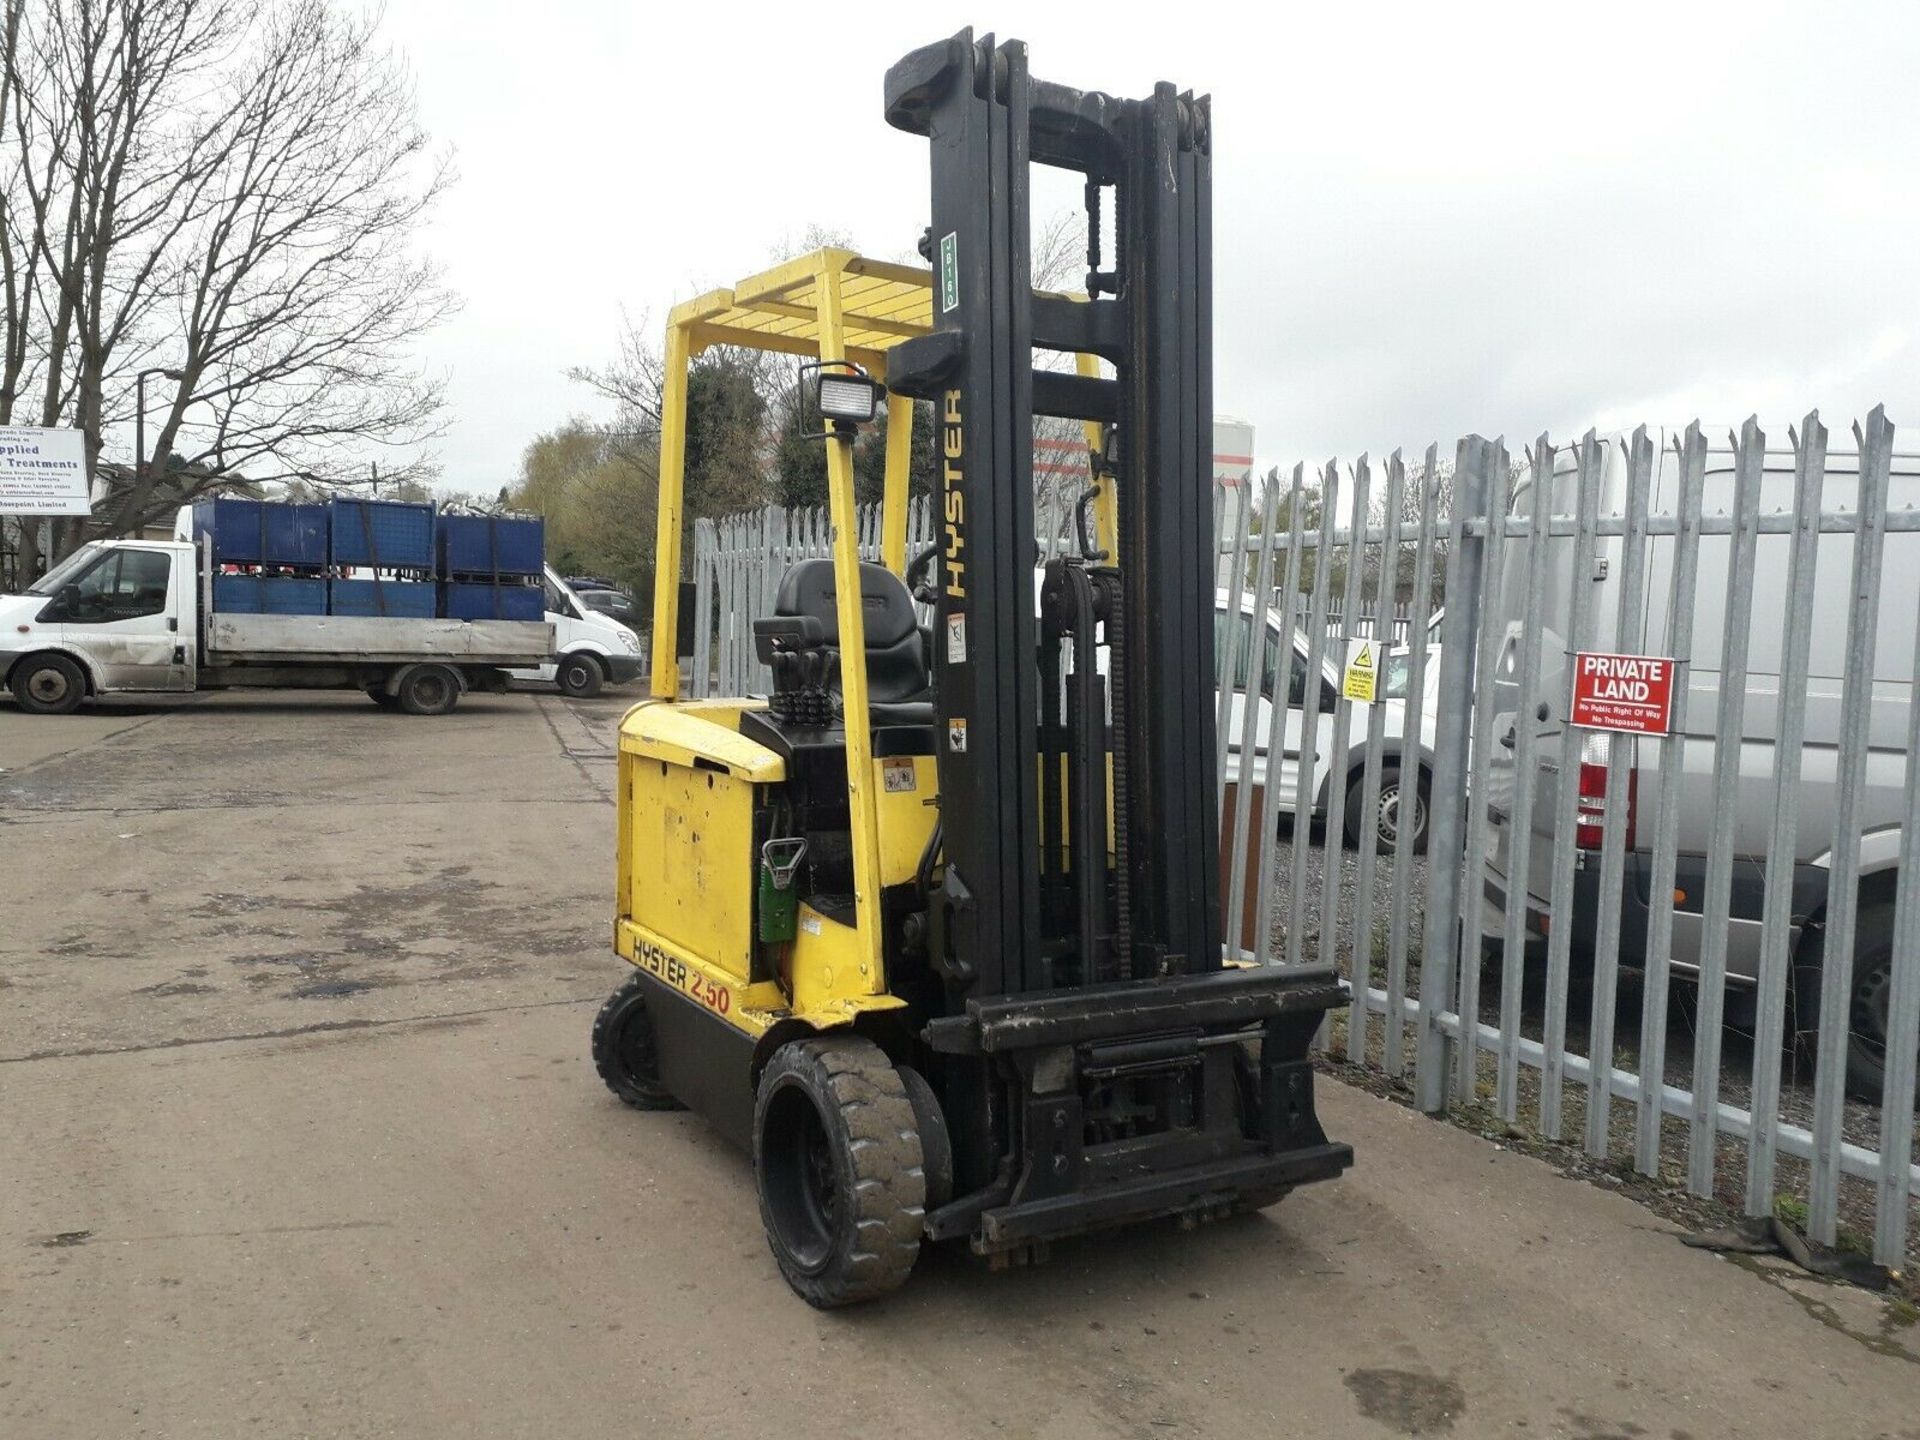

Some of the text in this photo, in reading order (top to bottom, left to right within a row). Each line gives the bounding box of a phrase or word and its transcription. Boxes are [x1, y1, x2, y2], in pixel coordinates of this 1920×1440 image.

[7, 458, 78, 468] Treatments
[943, 389, 965, 598] HYSTER
[1584, 657, 1662, 681] PRIVATE
[1593, 678, 1650, 701] LAND
[1579, 703, 1661, 719] No Public Right Of Way
[1592, 715, 1645, 728] No Trespassing
[633, 936, 729, 1014] HYSTER 2.50
